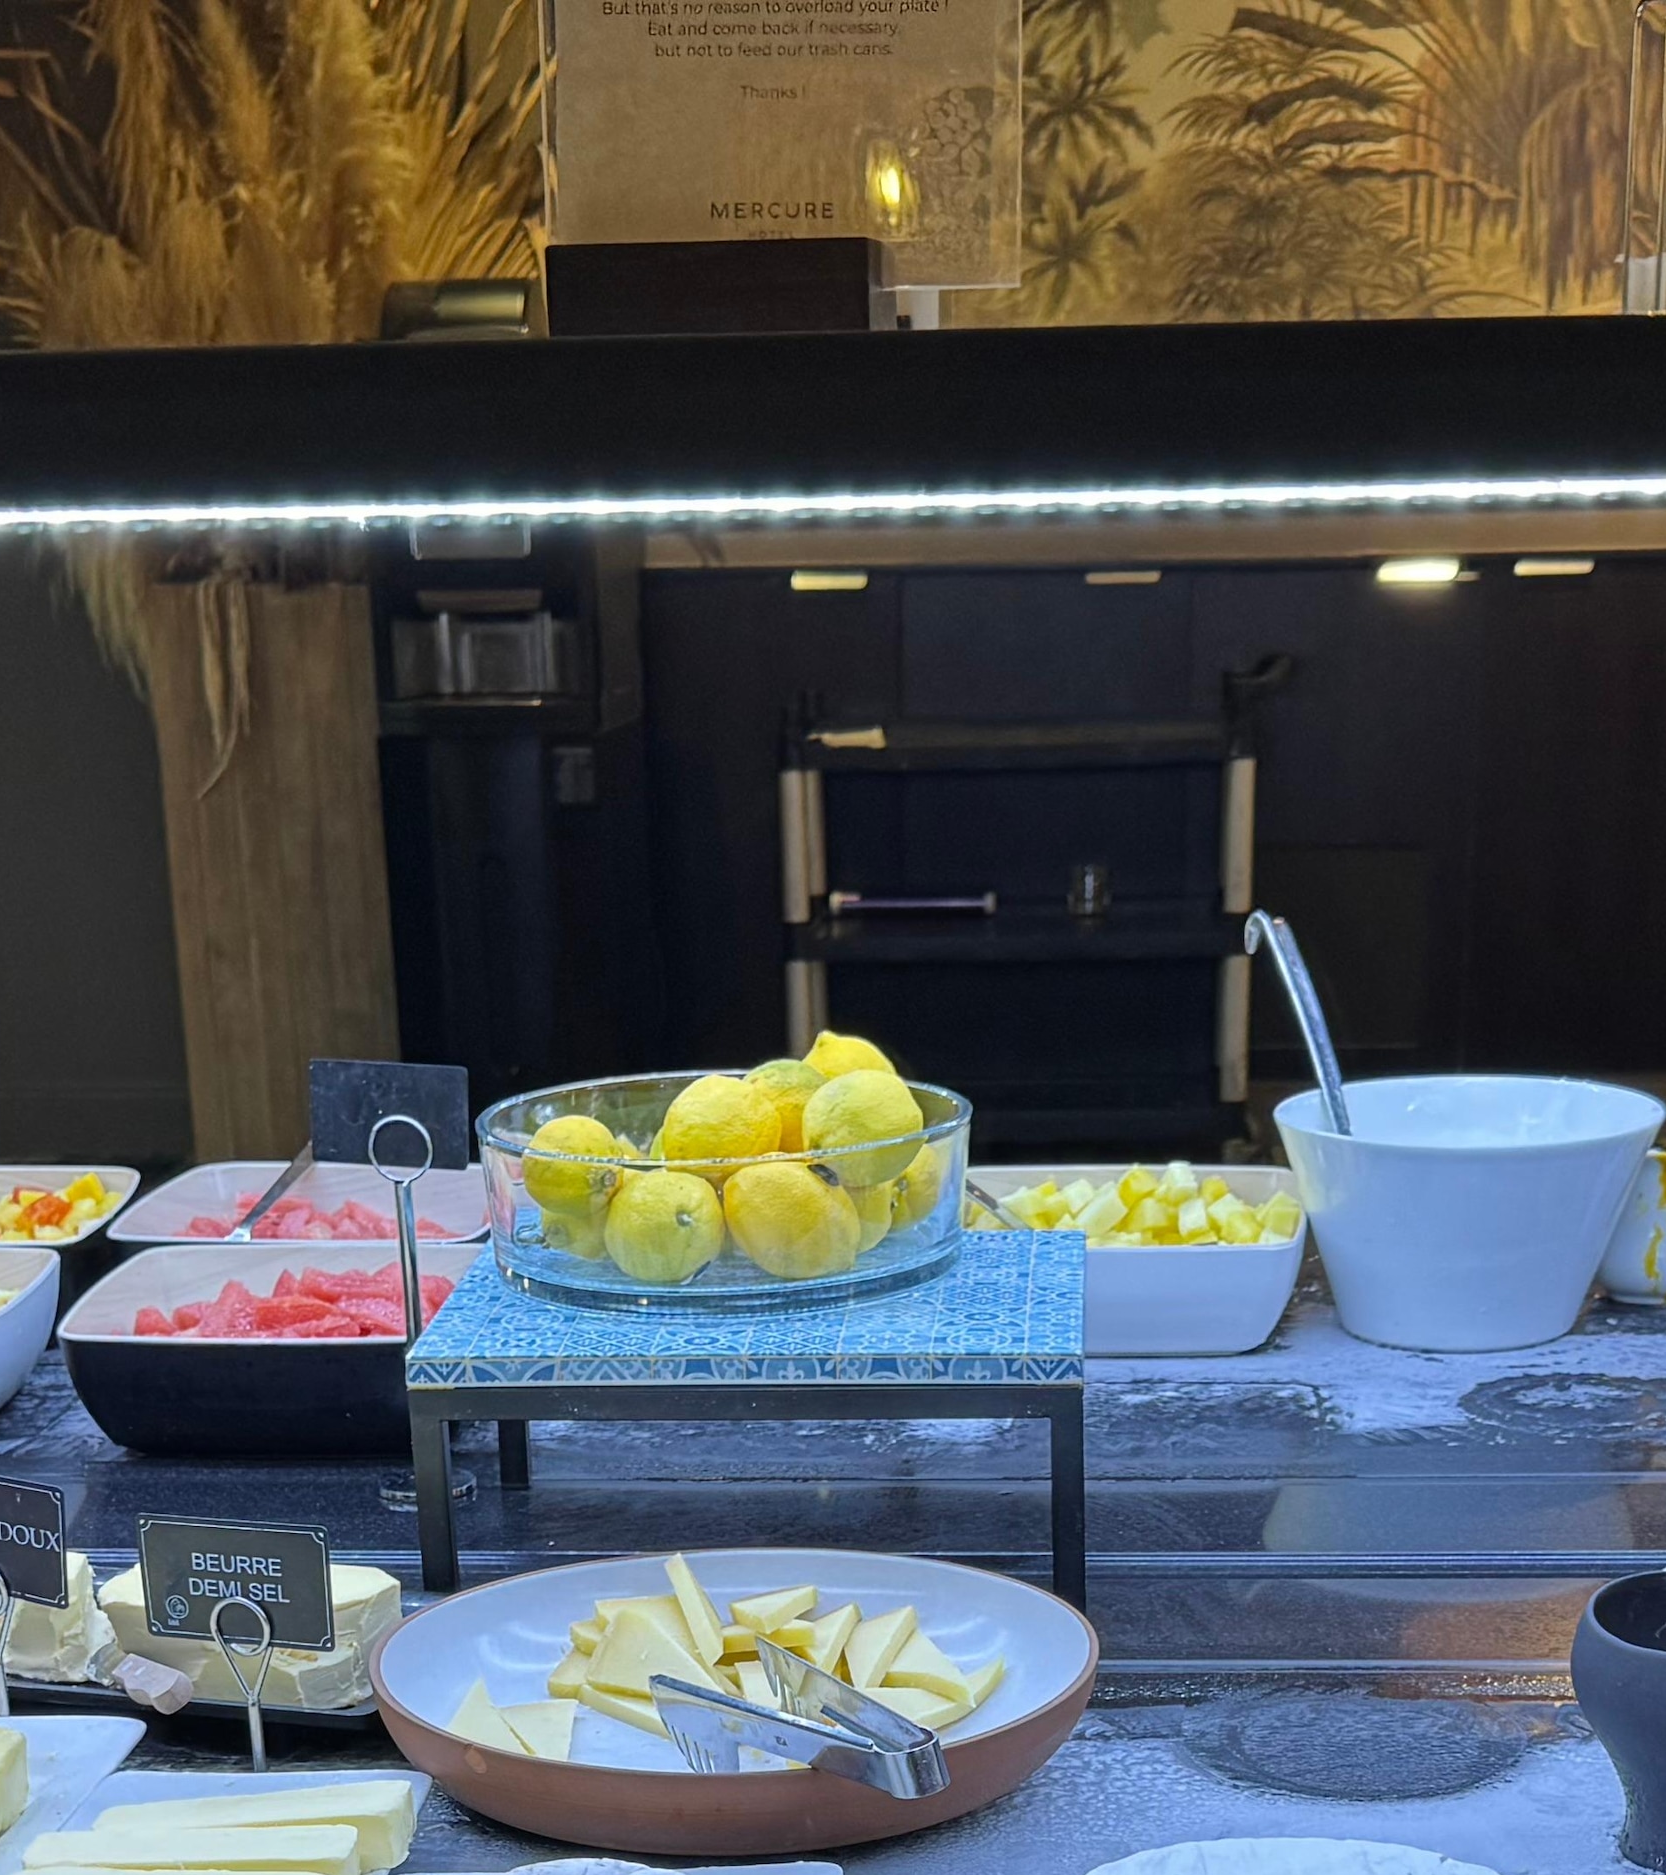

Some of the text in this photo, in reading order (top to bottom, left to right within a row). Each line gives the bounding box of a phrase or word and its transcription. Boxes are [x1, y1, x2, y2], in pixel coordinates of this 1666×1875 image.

[602, 1, 630, 15] But
[635, 1, 678, 15] that's
[683, 2, 703, 15] no
[708, 2, 760, 14] reason
[766, 1, 781, 13] to
[785, 0, 853, 13] overload
[859, 1, 893, 15] your
[899, 0, 939, 14] plate
[648, 20, 672, 36] Eat
[678, 20, 707, 36] and
[713, 23, 757, 36] come
[762, 20, 799, 35] back
[805, 20, 814, 34] if
[655, 42, 681, 57] but
[687, 43, 713, 57] not
[718, 44, 733, 57] to
[739, 42, 772, 57] feed
[777, 45, 804, 56] our
[809, 43, 848, 56] trash
[740, 85, 797, 99] Thanks
[710, 202, 834, 219] MERCURE
[191, 1552, 283, 1577] BEURRE
[188, 1577, 291, 1603] DEMI SEL
